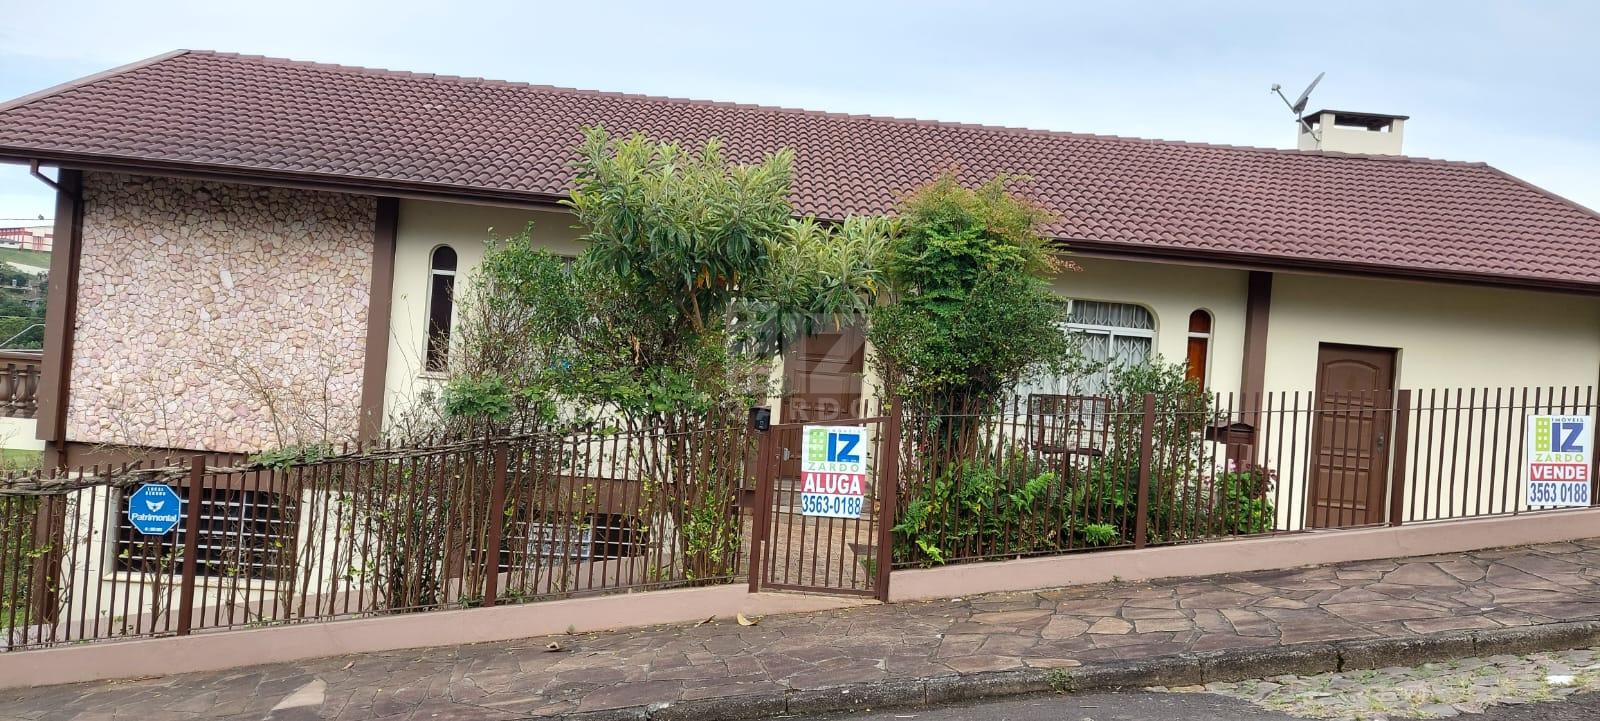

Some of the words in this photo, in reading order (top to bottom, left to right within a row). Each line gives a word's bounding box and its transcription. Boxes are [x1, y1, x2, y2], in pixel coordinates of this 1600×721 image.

[827, 432, 860, 463] IZ
[1551, 422, 1584, 452] IZ
[808, 463, 860, 473] ZARDO
[1535, 453, 1584, 462] ZARDO
[1531, 465, 1586, 480] VENDE
[803, 473, 862, 495] ALUGA
[1530, 482, 1557, 502] 3563
[1560, 483, 1587, 503] 0188
[802, 494, 861, 515] 3563-0188
[131, 512, 177, 522] Patrimonial
